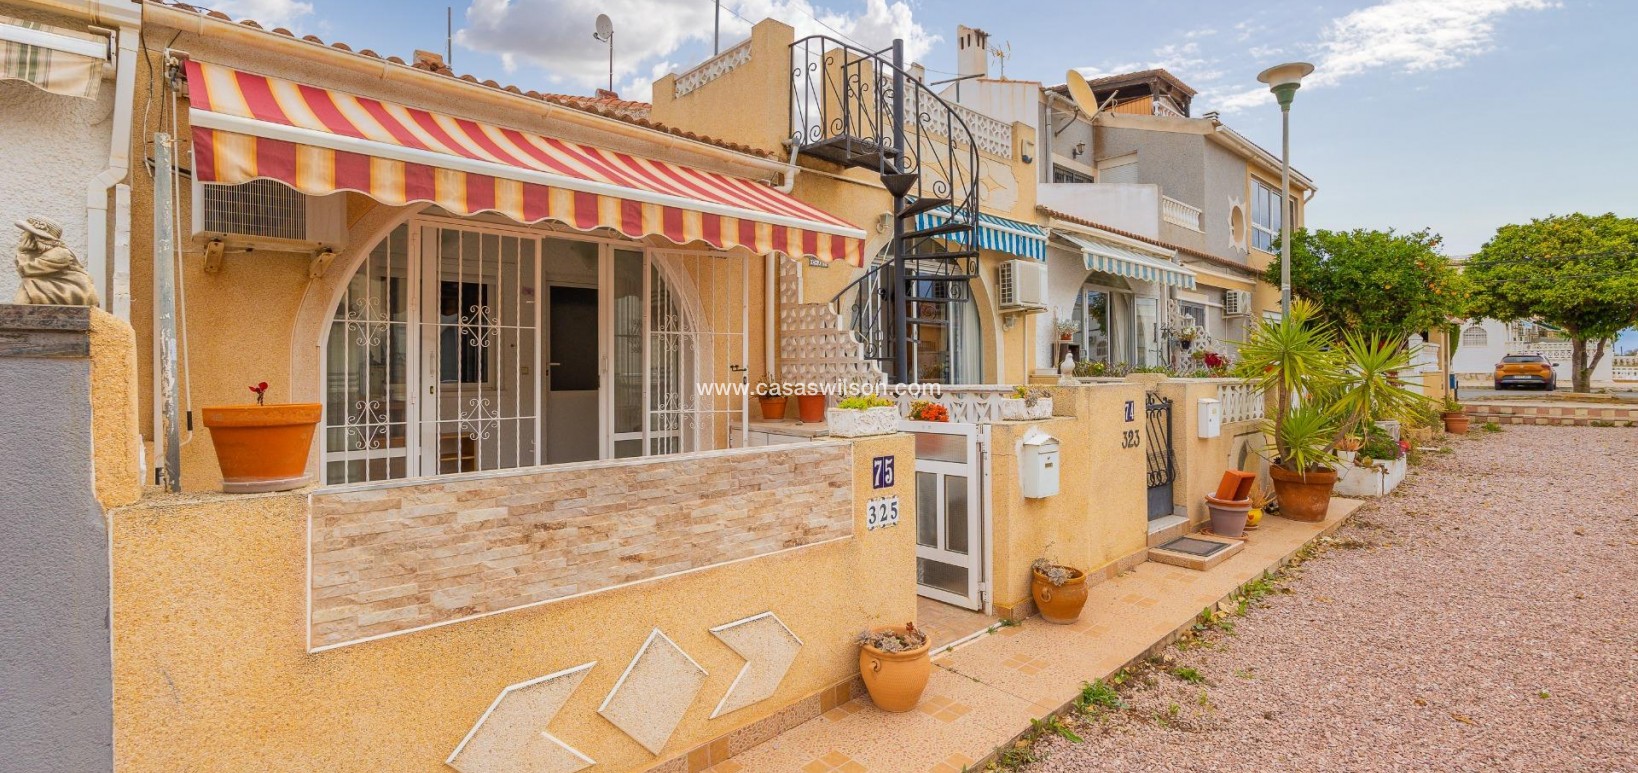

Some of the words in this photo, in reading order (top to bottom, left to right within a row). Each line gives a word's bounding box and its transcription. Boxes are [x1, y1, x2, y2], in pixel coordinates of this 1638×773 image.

[1125, 402, 1134, 420] 74
[1122, 430, 1140, 449] 323
[874, 458, 893, 486] 75
[869, 501, 897, 524] 325
